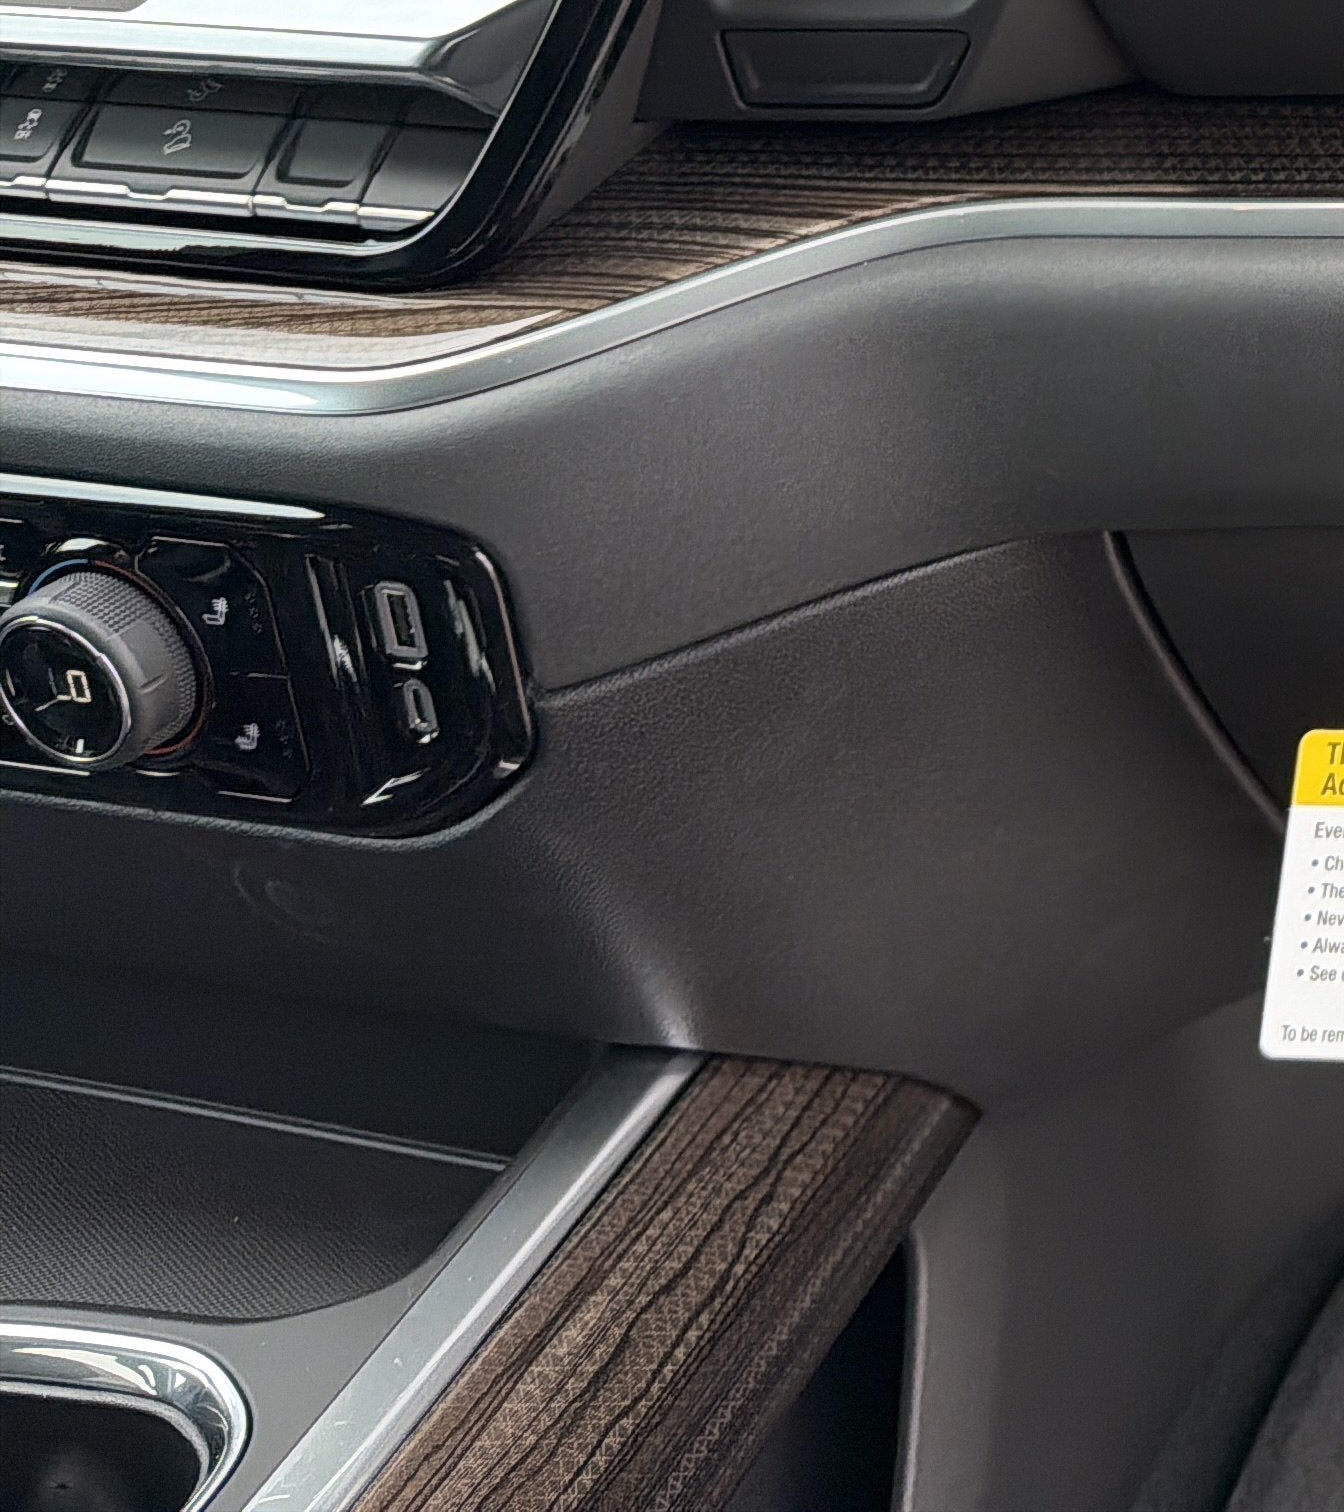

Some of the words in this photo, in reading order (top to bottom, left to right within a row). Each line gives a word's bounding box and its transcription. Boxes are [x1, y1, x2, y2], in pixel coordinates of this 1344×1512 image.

[1309, 965, 1337, 982] See
[1281, 1024, 1296, 1042] To
[1300, 1026, 1317, 1042] be
